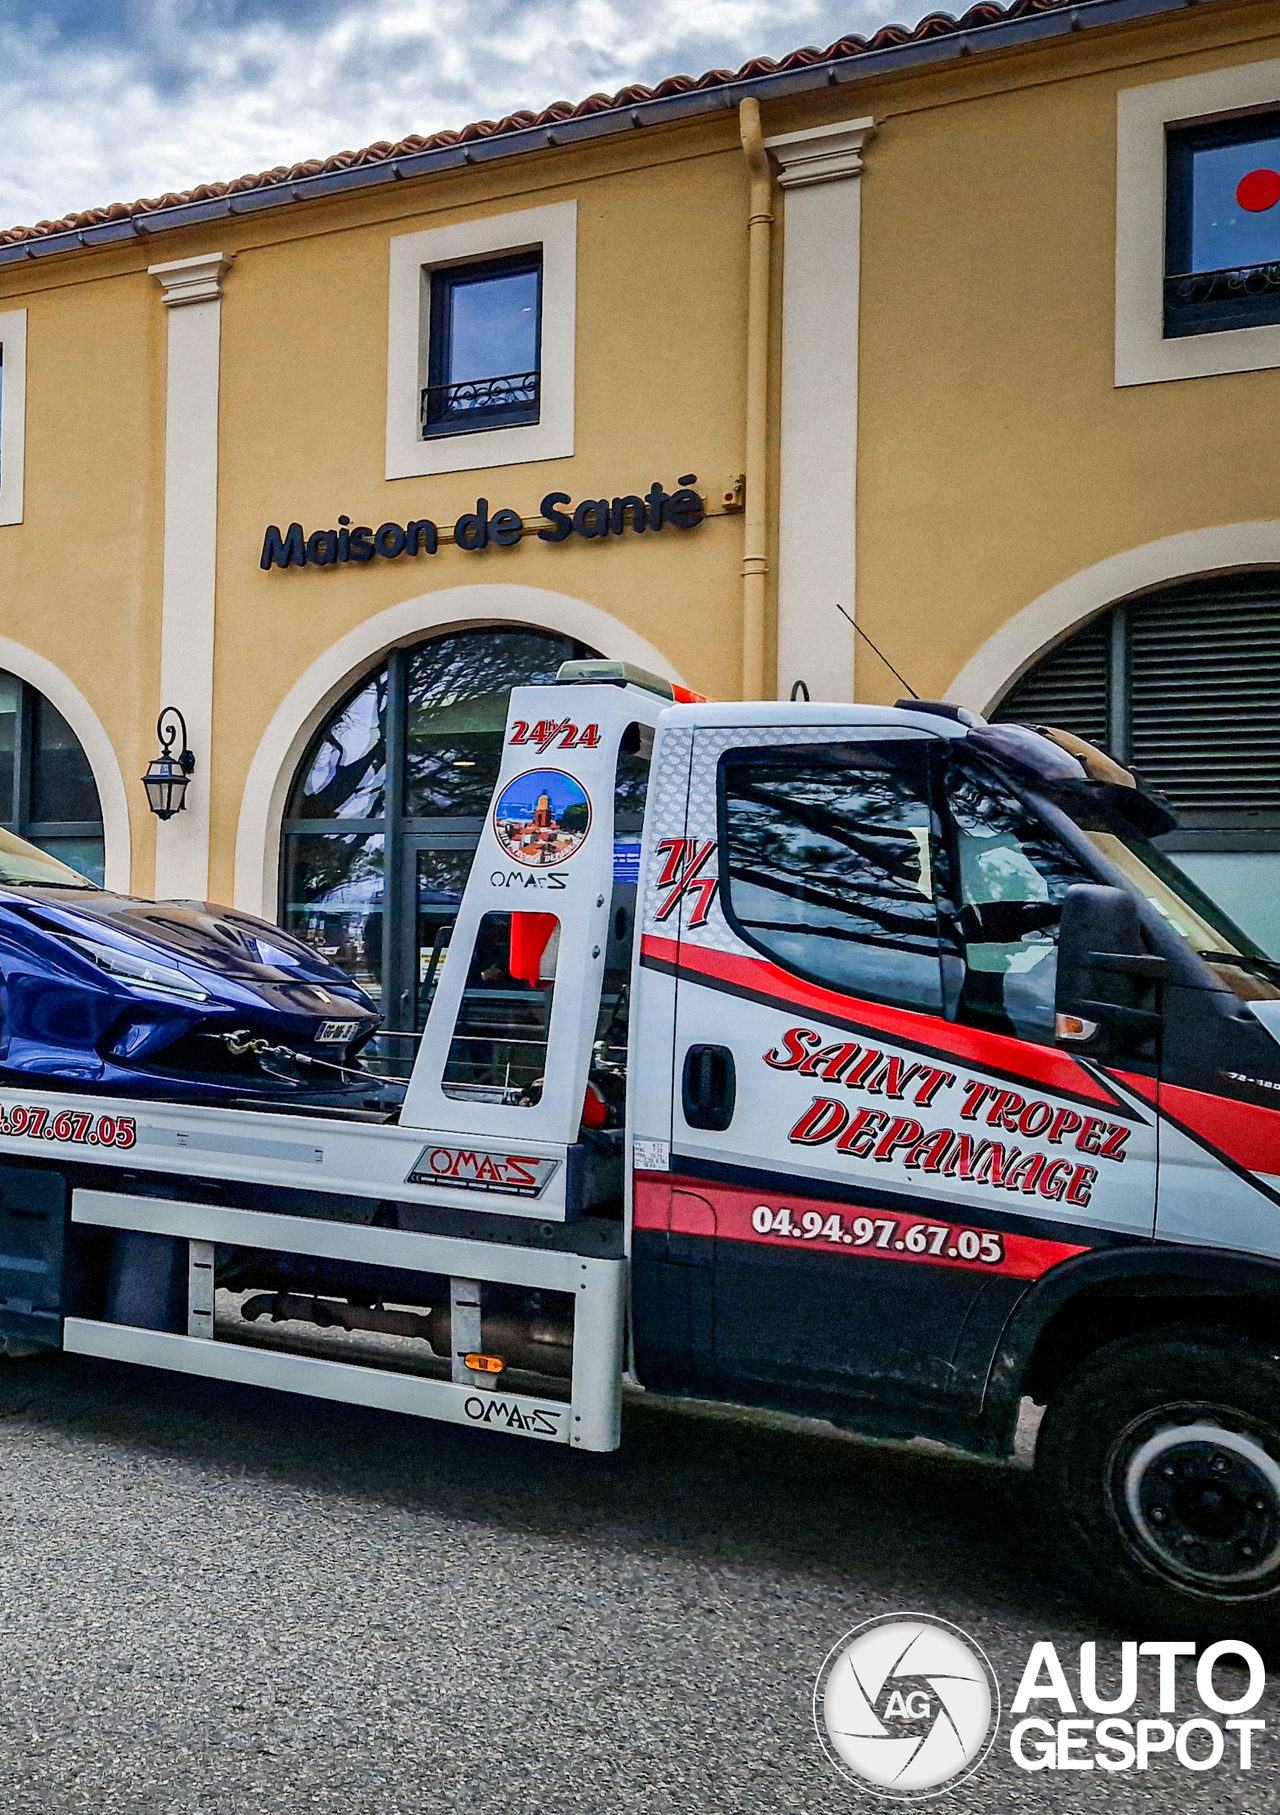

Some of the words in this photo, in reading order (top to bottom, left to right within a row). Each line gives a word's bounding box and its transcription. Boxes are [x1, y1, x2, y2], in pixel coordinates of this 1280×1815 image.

[259, 515, 438, 571] Maison
[455, 498, 523, 551] de
[538, 473, 706, 542] Santé
[762, 1026, 957, 1108] SAINT
[959, 1079, 1132, 1163] TROPEZ
[788, 1095, 1098, 1209] DEPANNAGE
[751, 1204, 1006, 1264] 04.94.97.67.05
